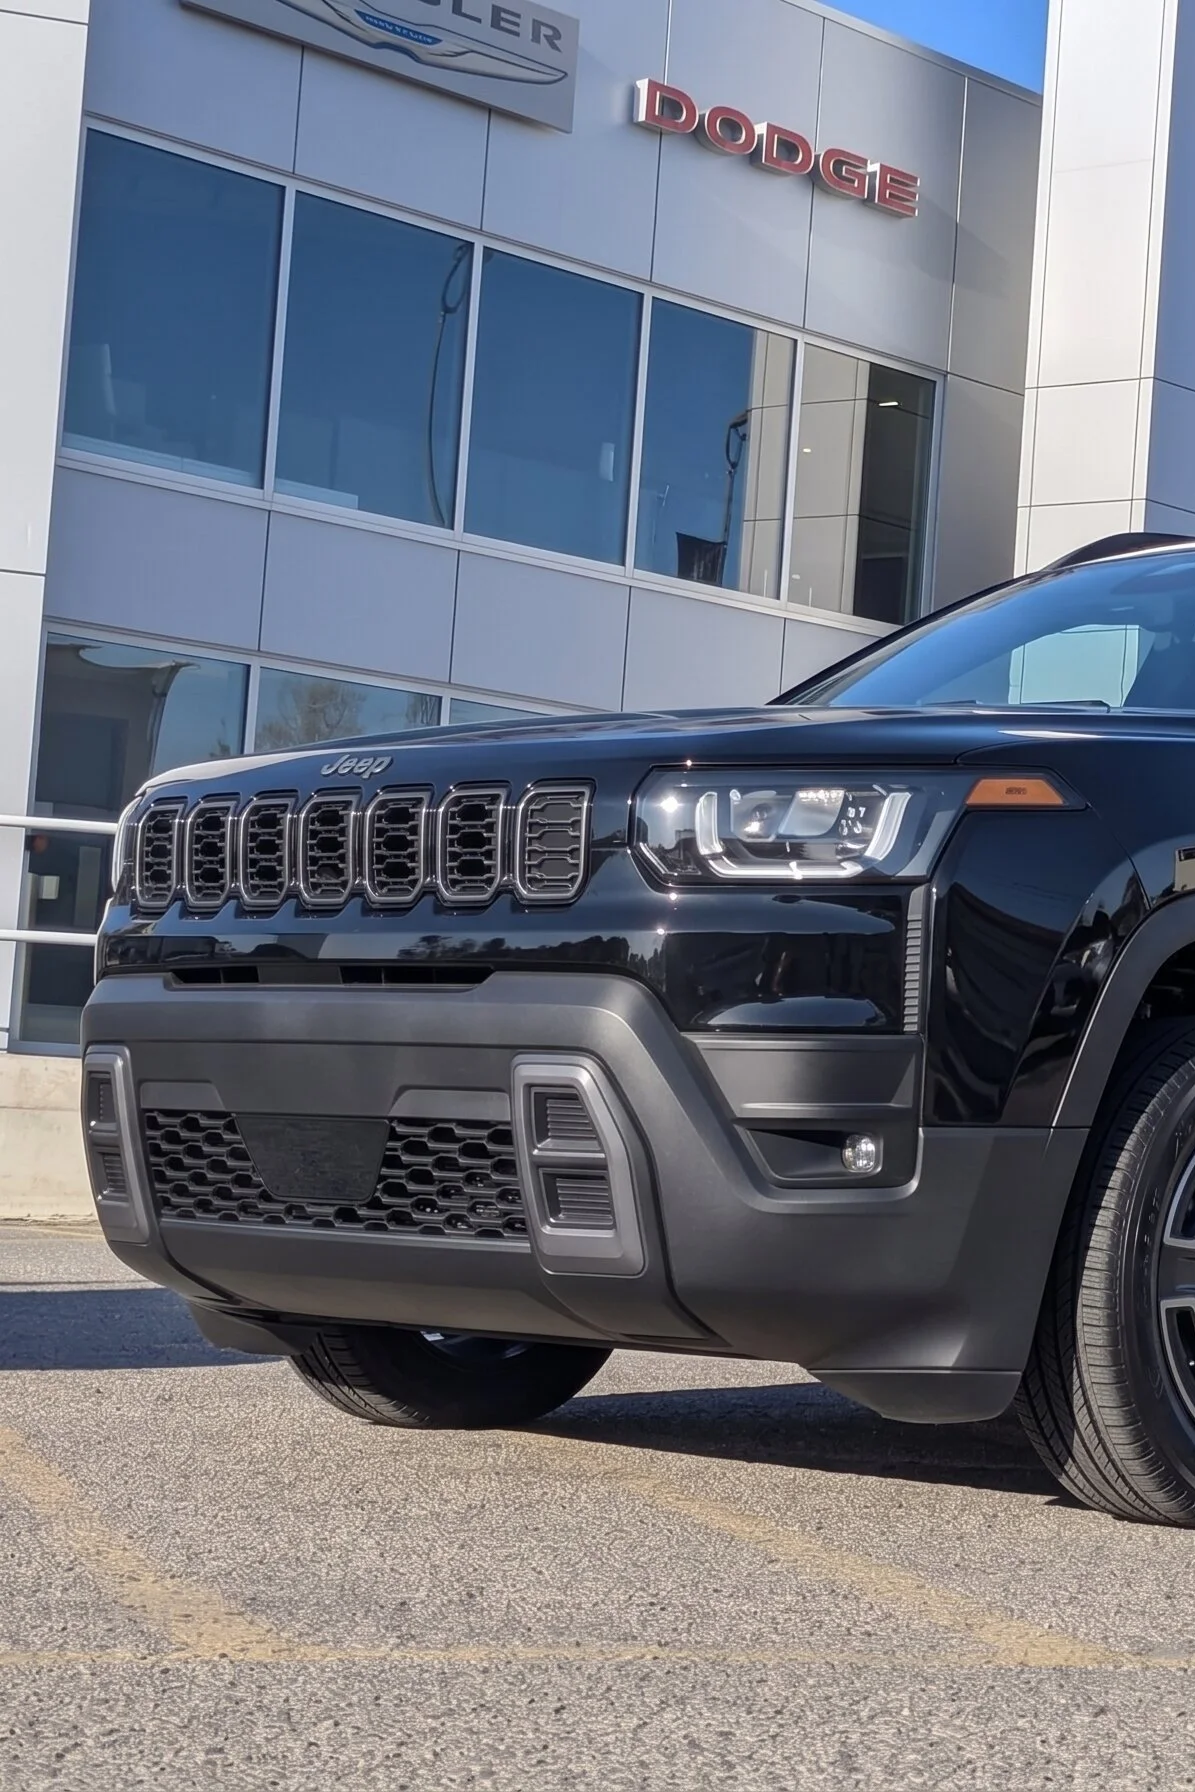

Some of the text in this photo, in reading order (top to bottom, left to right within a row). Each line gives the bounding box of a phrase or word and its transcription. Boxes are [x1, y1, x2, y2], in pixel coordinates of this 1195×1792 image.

[414, 0, 563, 52] LER
[634, 78, 920, 218] DODGE
[320, 754, 393, 779] Jeep
